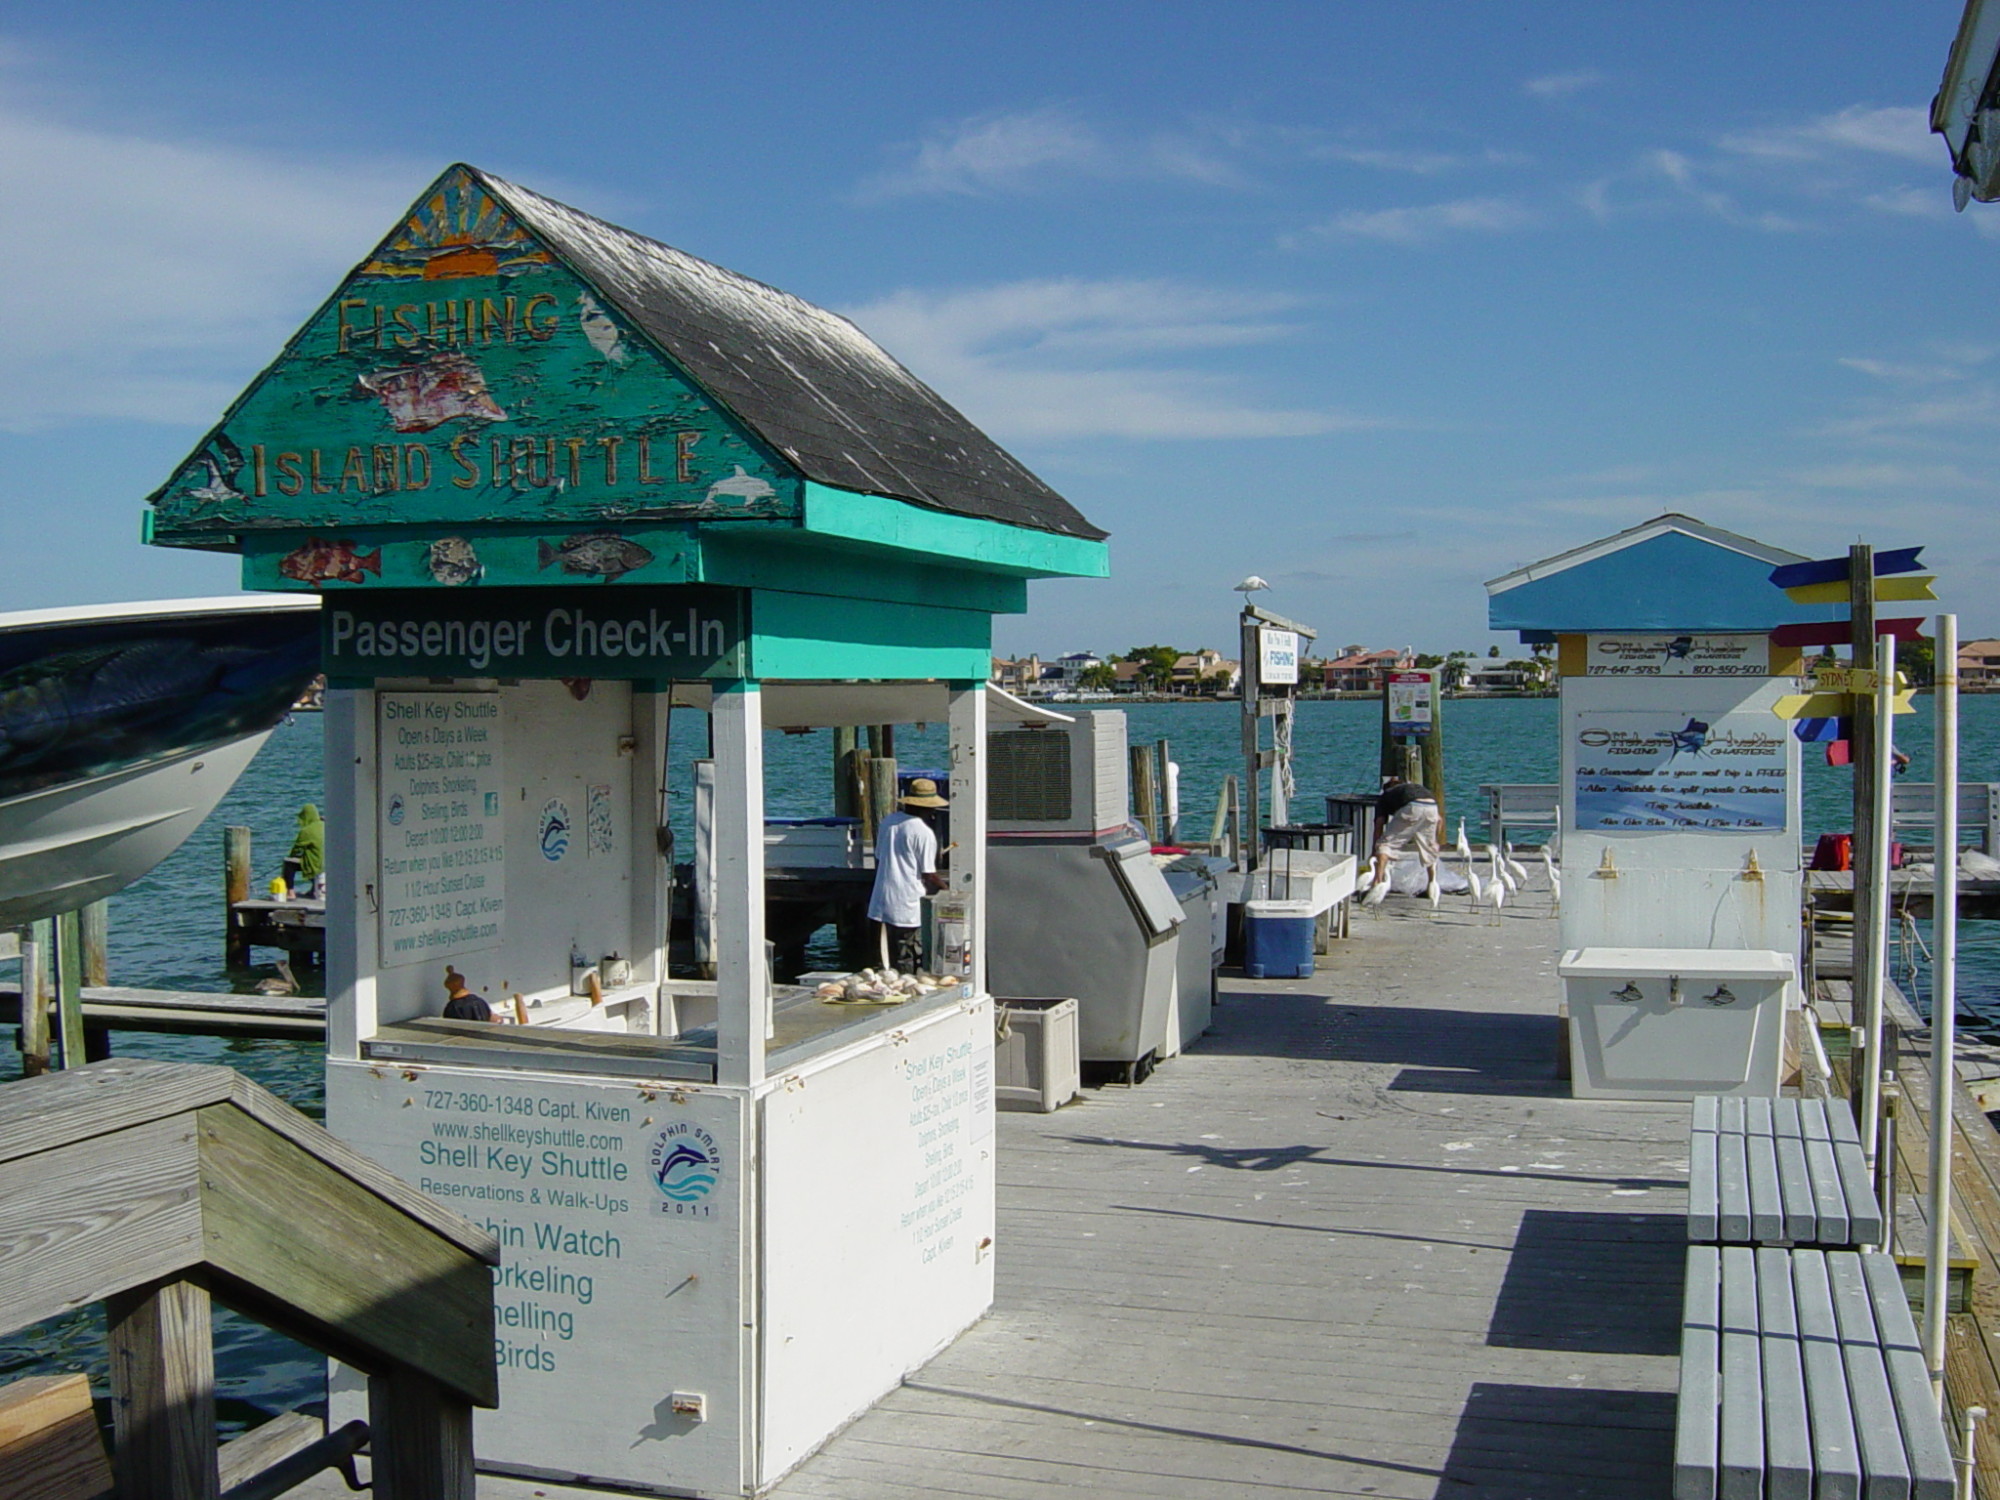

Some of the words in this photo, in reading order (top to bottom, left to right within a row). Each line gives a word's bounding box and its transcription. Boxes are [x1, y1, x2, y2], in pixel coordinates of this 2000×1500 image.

[338, 292, 560, 353] FISHING
[252, 442, 432, 497] ISLAND
[332, 610, 532, 669] Passenger
[545, 607, 726, 657] Check-In
[1819, 672, 1855, 687] SYDNEY
[386, 701, 420, 719] Shell
[424, 702, 450, 722] Key
[454, 701, 498, 719] Shuttle
[398, 726, 422, 749] Open
[432, 726, 455, 748] Days
[464, 725, 488, 742] Week
[905, 1060, 926, 1081] Shell
[929, 1054, 945, 1072] Key
[424, 1089, 533, 1117] 727-360-1348
[538, 1098, 579, 1123] Capt.
[585, 1101, 631, 1123] Kiven
[432, 1122, 623, 1152] www.shellkeyshuttle.com
[651, 1123, 688, 1166] DOLPHIN
[694, 1128, 720, 1174] SMART
[419, 1140, 479, 1170] Shell
[487, 1146, 533, 1180] Key
[541, 1151, 629, 1182] Shuttle
[420, 1177, 525, 1204] Reservations
[530, 1188, 542, 1205] &
[547, 1189, 630, 1214] Walk-Ups
[534, 1222, 622, 1259] Watch
